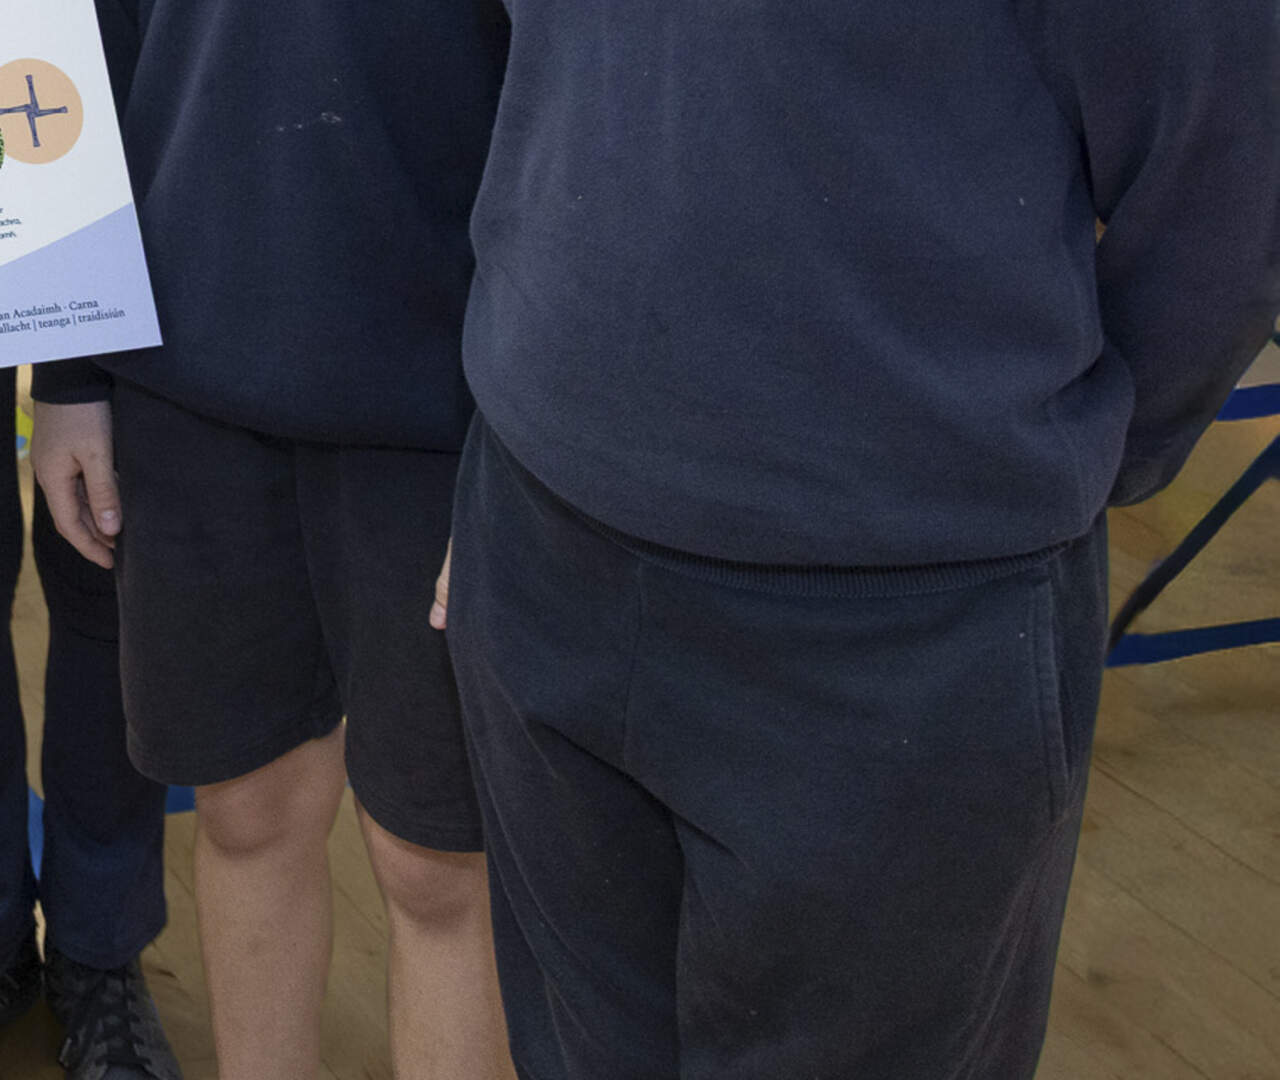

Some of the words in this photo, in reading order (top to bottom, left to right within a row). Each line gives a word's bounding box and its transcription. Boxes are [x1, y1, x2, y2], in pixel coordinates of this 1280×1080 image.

[12, 302, 62, 319] Acadaimh
[68, 300, 99, 311] Carna
[37, 316, 71, 328] teanga
